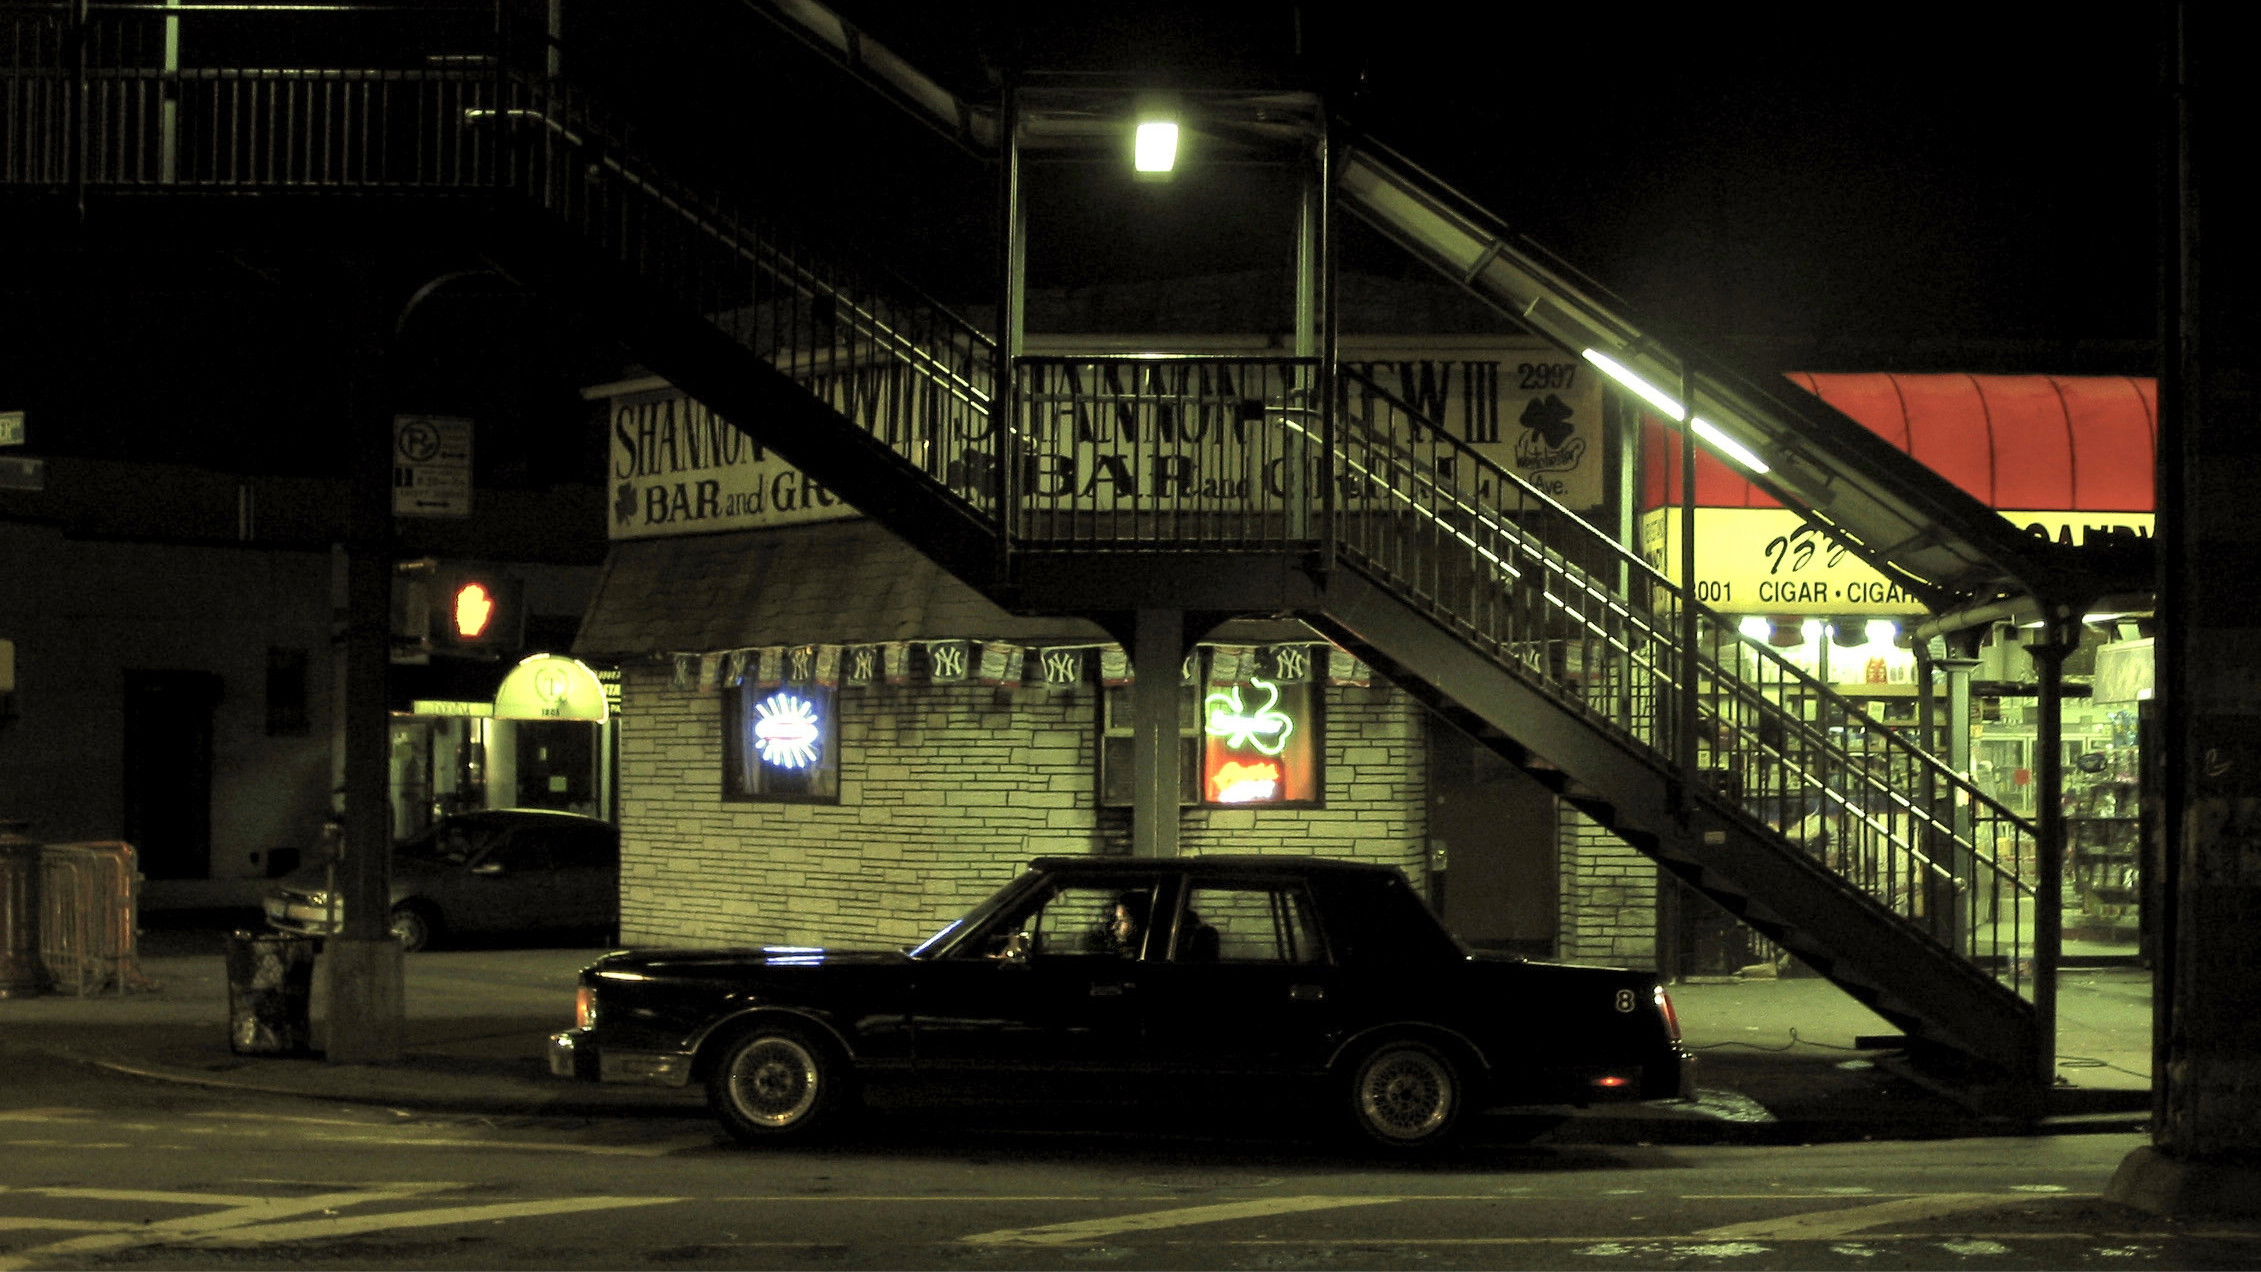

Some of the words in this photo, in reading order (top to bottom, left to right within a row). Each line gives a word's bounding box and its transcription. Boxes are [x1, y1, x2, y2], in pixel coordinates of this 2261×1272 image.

[1516, 362, 1578, 390] 2997
[1462, 361, 1500, 443] III
[1023, 454, 1198, 498] BAR
[644, 479, 721, 526] BAR
[725, 473, 764, 516] and
[1694, 581, 1731, 602] 001
[1758, 581, 1828, 603] CIGAR
[934, 646, 962, 677] NY
[1048, 652, 1077, 684] NY
[1276, 649, 1305, 680] NY
